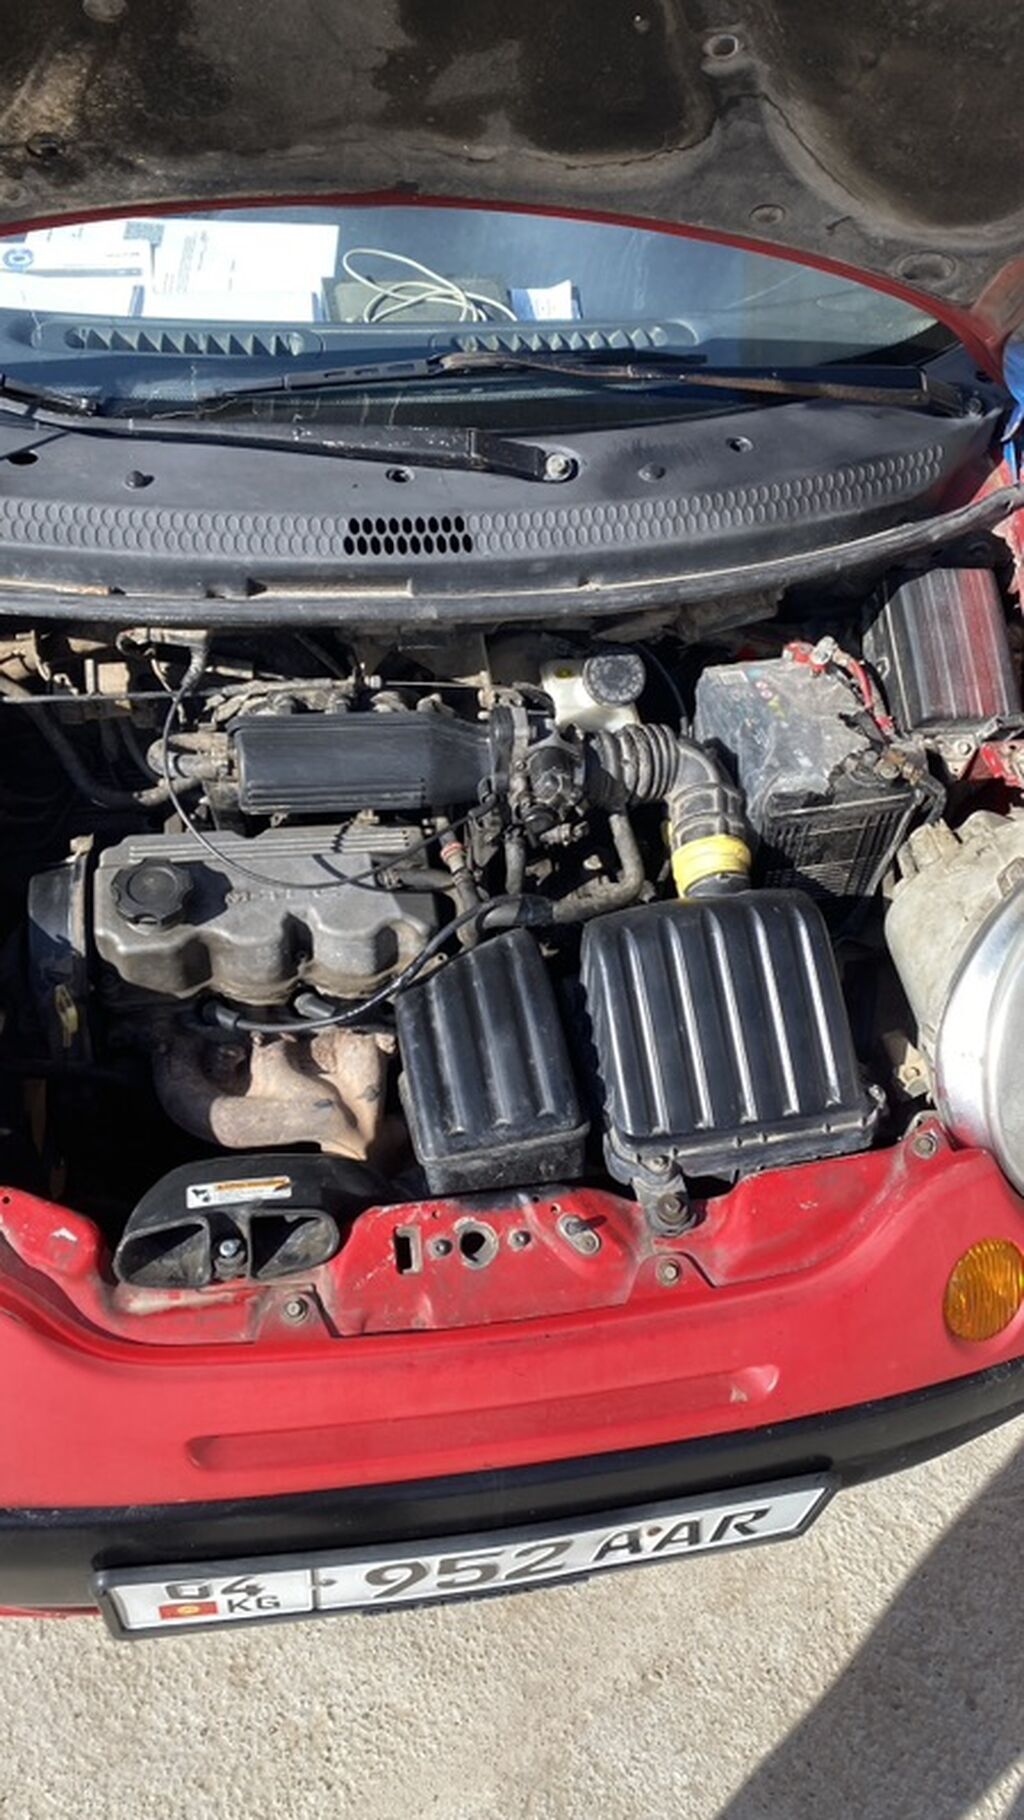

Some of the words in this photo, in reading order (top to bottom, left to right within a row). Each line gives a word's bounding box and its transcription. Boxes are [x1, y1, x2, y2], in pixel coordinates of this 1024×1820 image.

[364, 1540, 574, 1599] 952
[593, 1506, 771, 1561] AAR
[228, 1595, 281, 1613] KG
